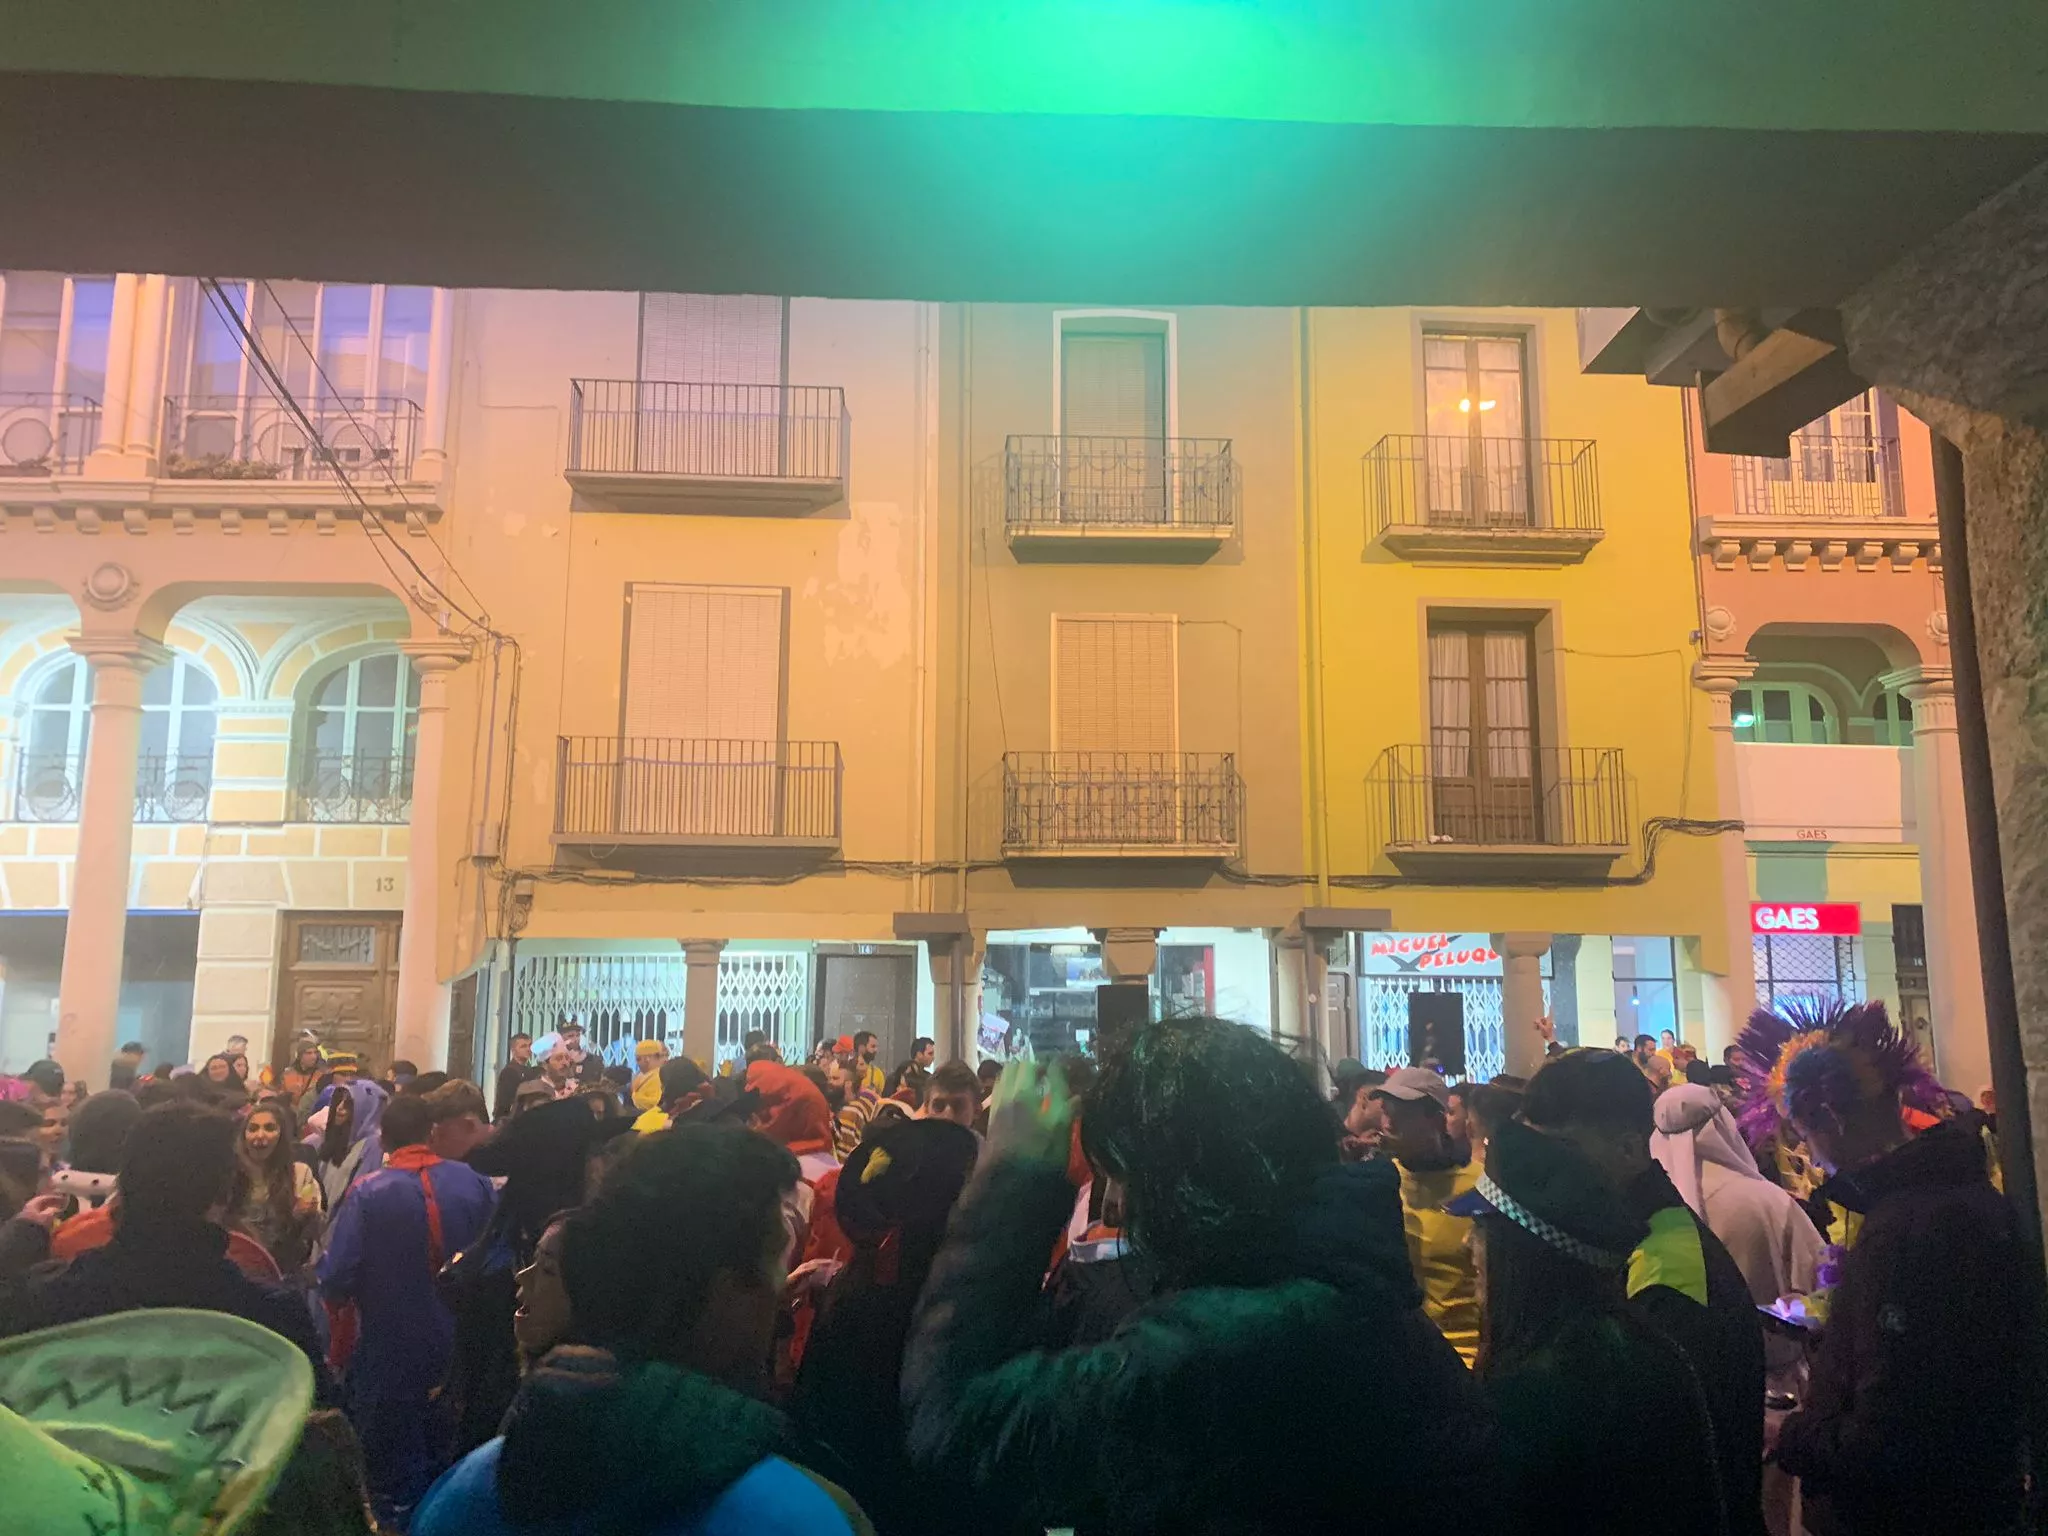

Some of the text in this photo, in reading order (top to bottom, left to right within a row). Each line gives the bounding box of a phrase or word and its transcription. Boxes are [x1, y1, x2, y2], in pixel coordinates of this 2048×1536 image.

[1796, 829, 1828, 840] GAES
[376, 877, 395, 892] 13
[1755, 907, 1820, 930] GAES
[1371, 932, 1449, 956] MIGUEL
